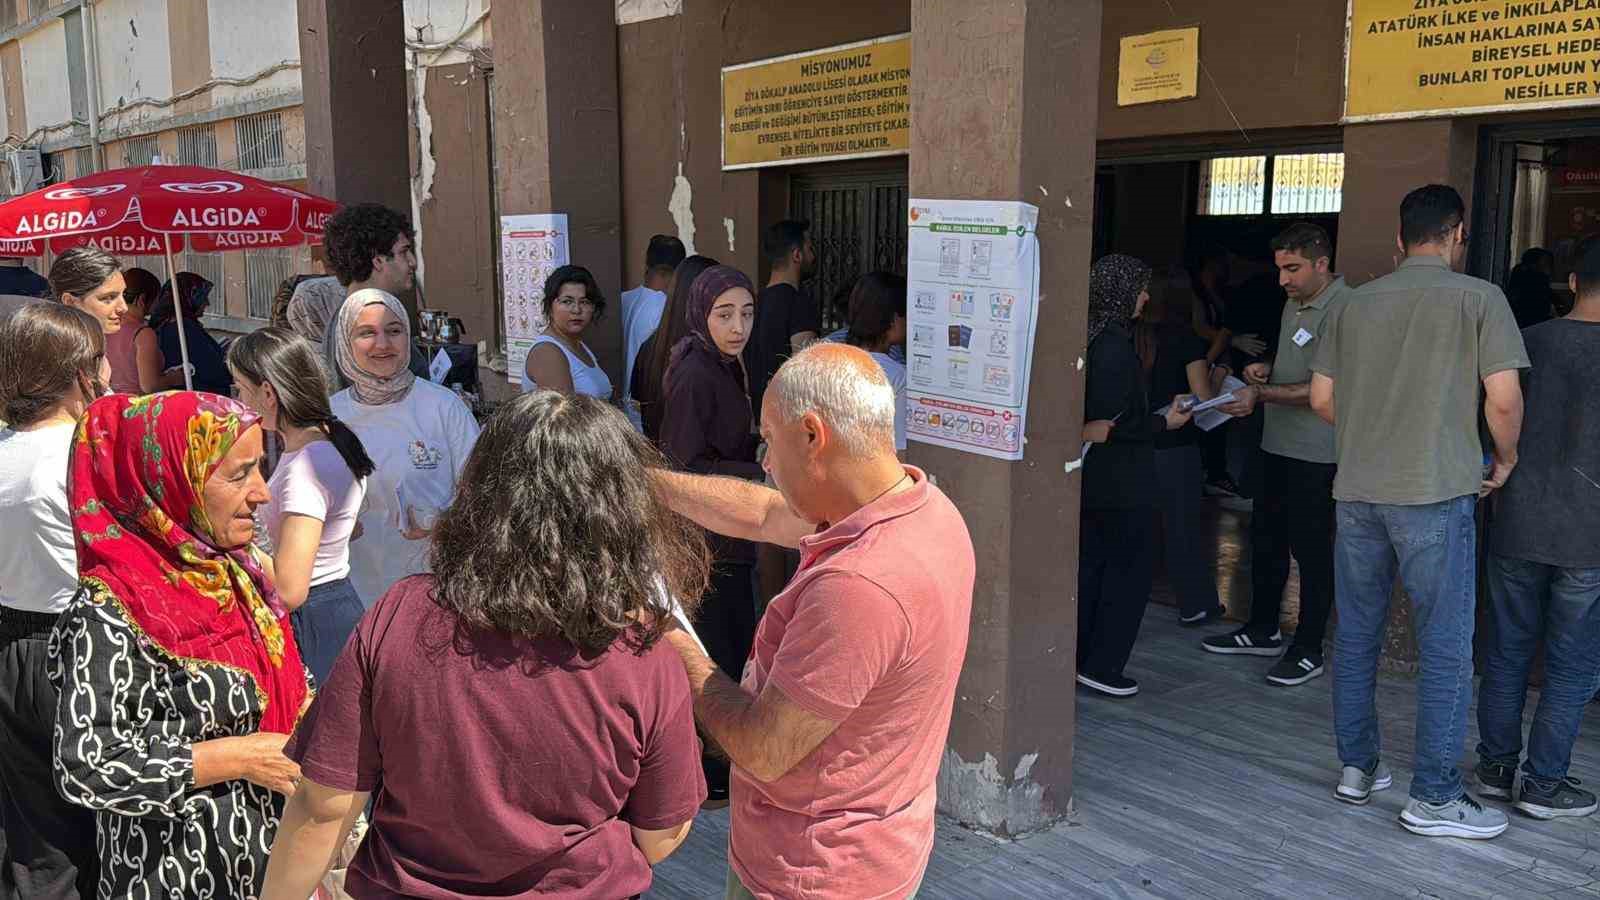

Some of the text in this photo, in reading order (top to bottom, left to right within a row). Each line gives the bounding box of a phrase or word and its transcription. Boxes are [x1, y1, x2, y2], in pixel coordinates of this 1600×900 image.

[1368, 0, 1600, 34] ATATÜRK İLKE ve İNKILAPLA
[1418, 32, 1466, 49] İNSAN
[1470, 20, 1567, 43] HAKLARINA
[1471, 38, 1600, 63] BİREYSEL HEDE
[801, 54, 871, 76] MİSYONUMUZ
[1418, 69, 1488, 87] BUNLARI
[1492, 61, 1586, 81] TOPLUMUN
[788, 80, 822, 96] ANADOLU
[824, 78, 846, 92] LİSESİ
[848, 74, 880, 87] OLARAK
[1504, 80, 1587, 100] NESİLLER
[823, 95, 846, 108] SAYGI
[877, 100, 905, 116] EĞİTİM
[831, 124, 844, 137] BİR
[821, 140, 847, 153] YUVASI
